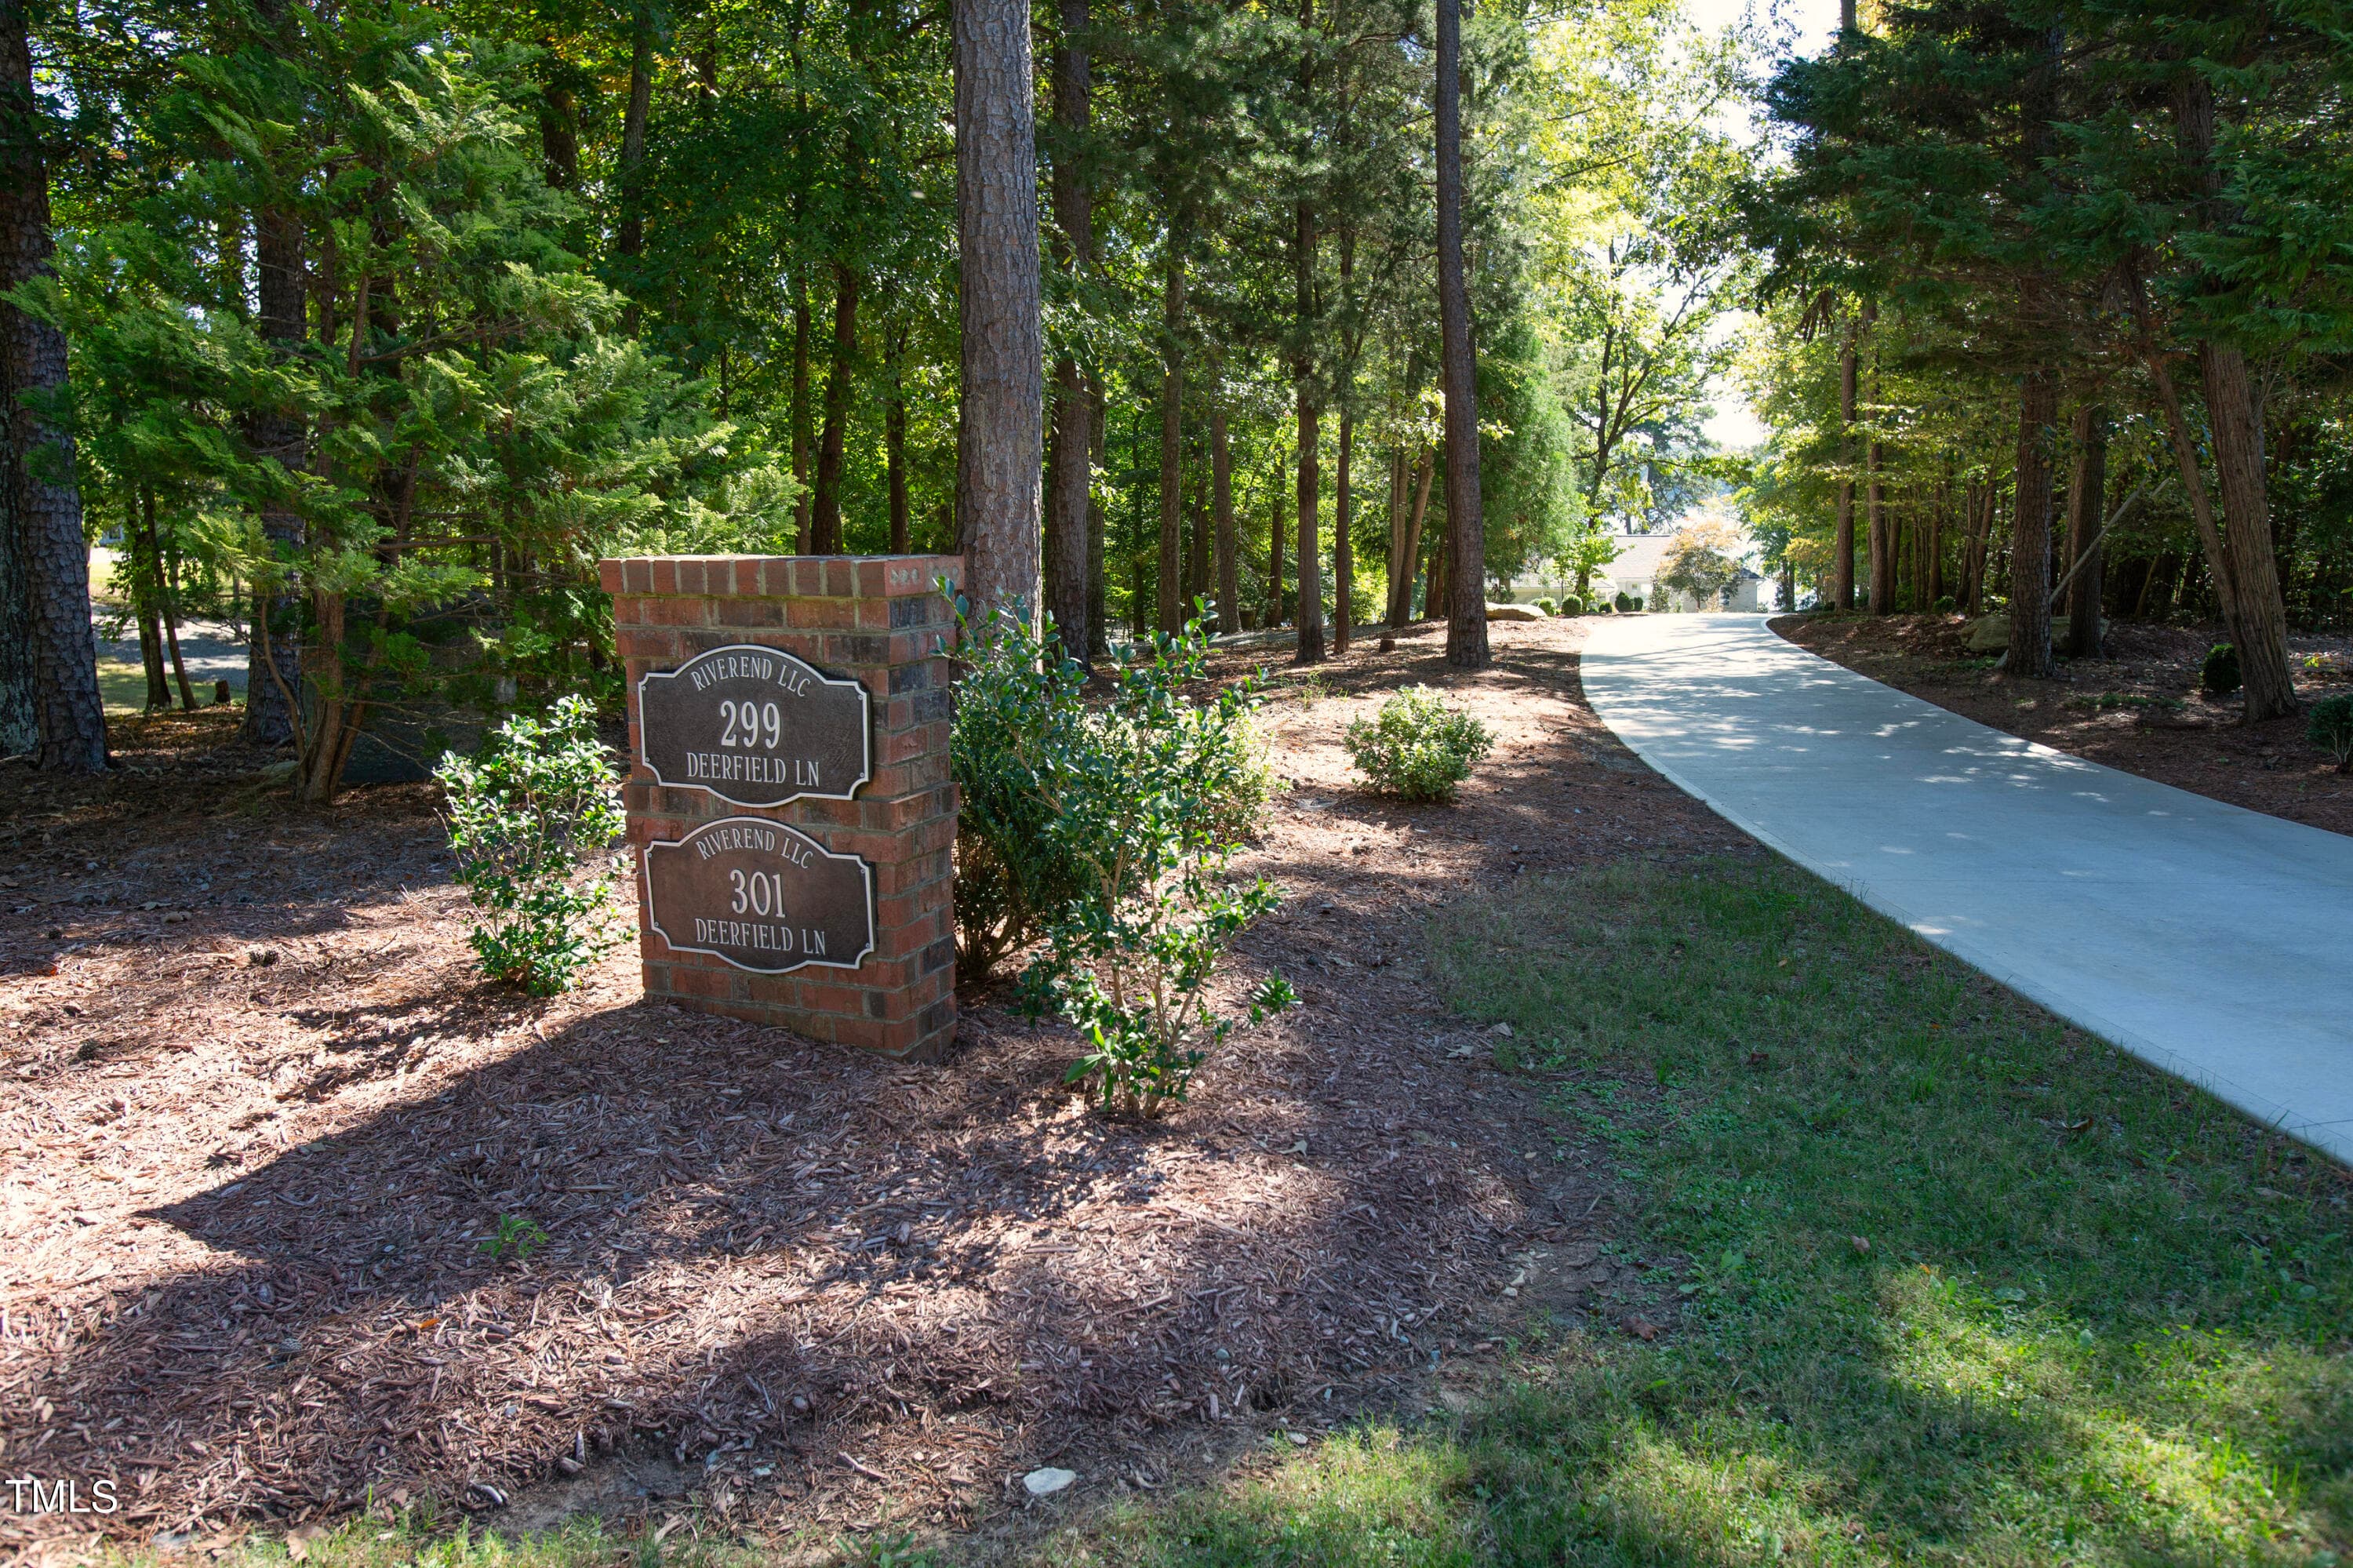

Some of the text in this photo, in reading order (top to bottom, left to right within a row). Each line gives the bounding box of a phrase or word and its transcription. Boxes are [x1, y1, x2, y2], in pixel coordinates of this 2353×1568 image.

[690, 657, 811, 697] RIVEREND LLC
[720, 700, 781, 750] 299
[686, 752, 820, 788] DEERFIELD LN
[695, 828, 813, 869] RIVEREND LLC
[729, 869, 786, 919] 301
[695, 918, 826, 956] DEERFIELD LN
